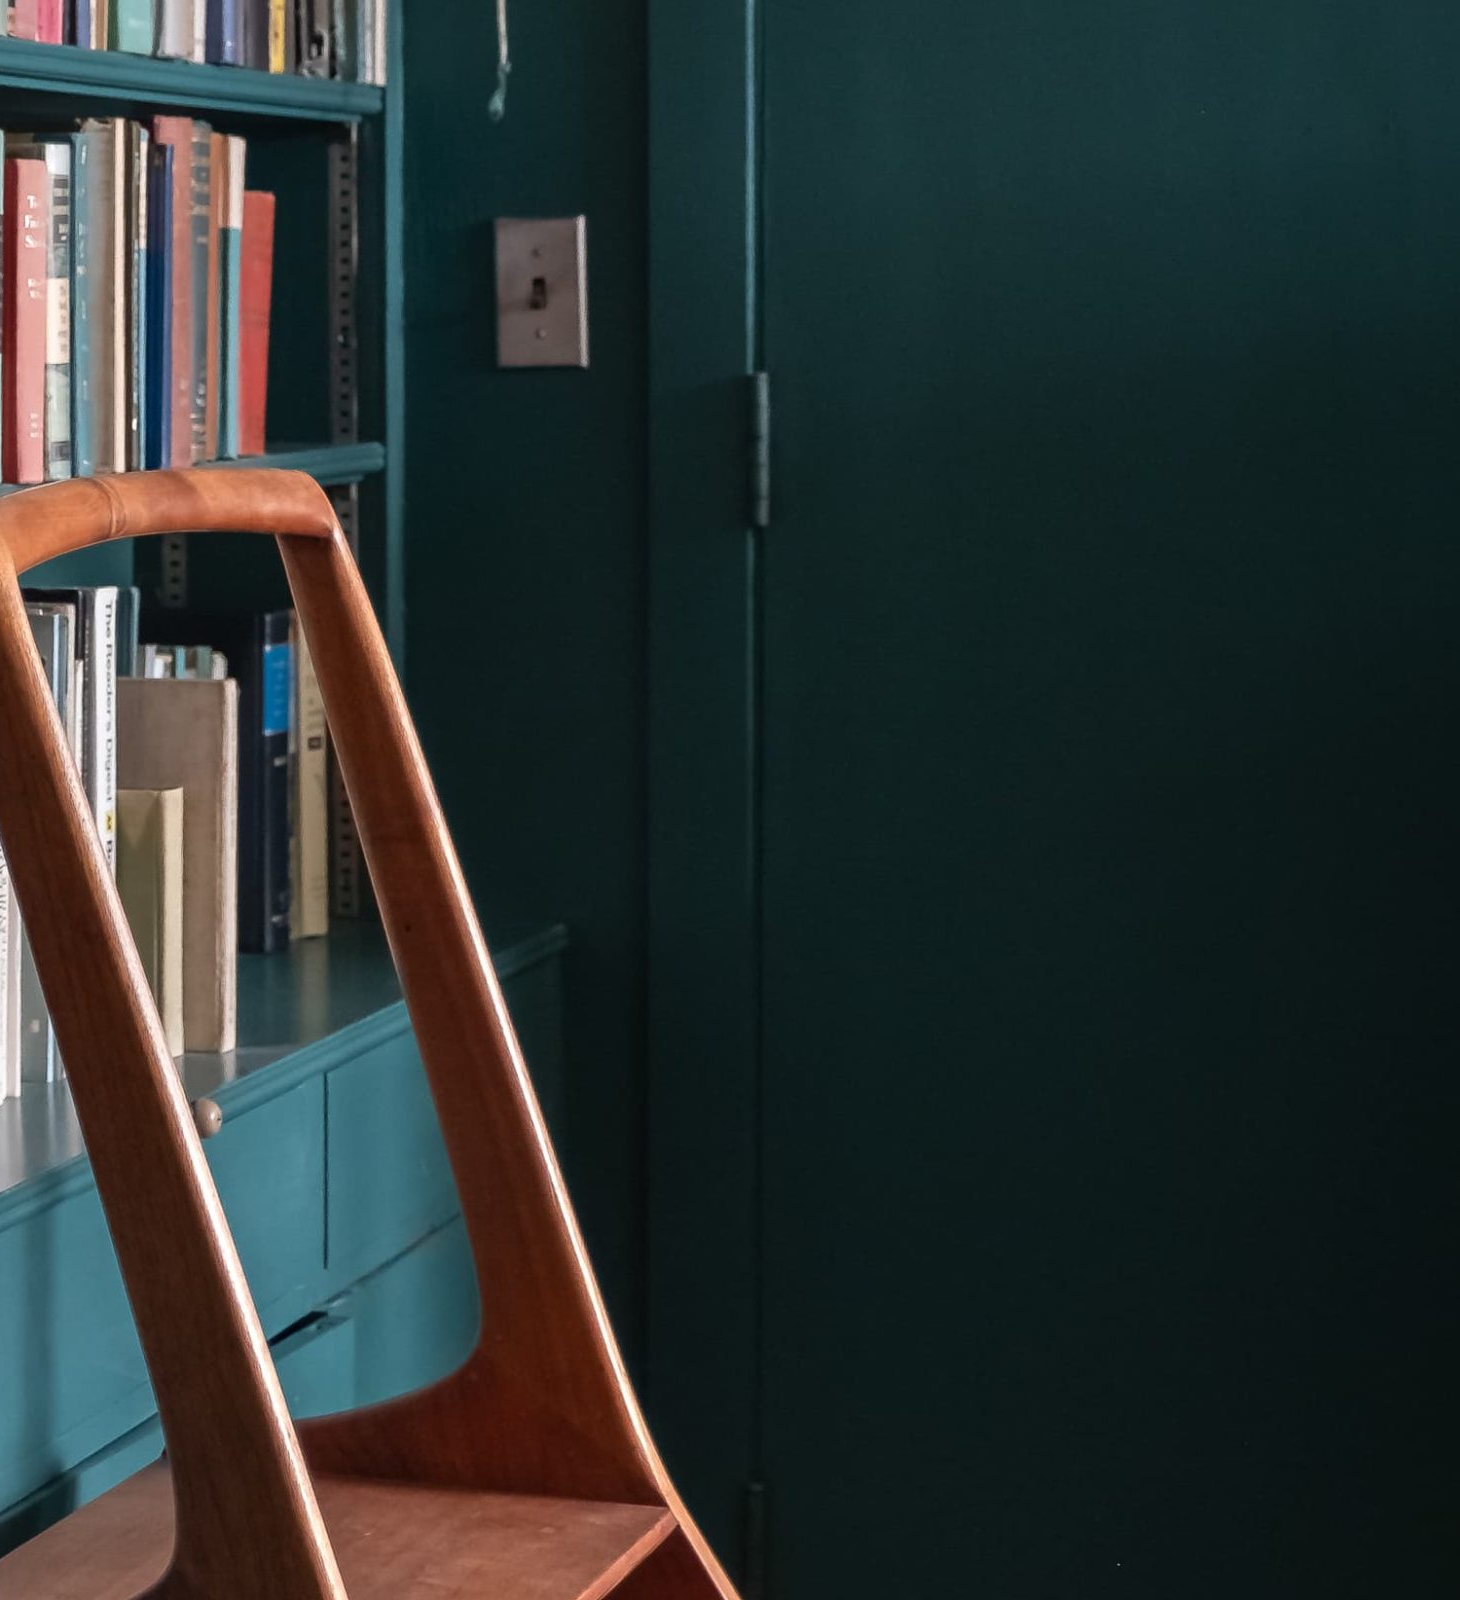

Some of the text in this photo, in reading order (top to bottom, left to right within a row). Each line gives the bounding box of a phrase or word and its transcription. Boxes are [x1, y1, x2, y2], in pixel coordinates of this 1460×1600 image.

[105, 603, 114, 639] The
[105, 643, 115, 733] Reader's
[105, 738, 116, 804] Digest
